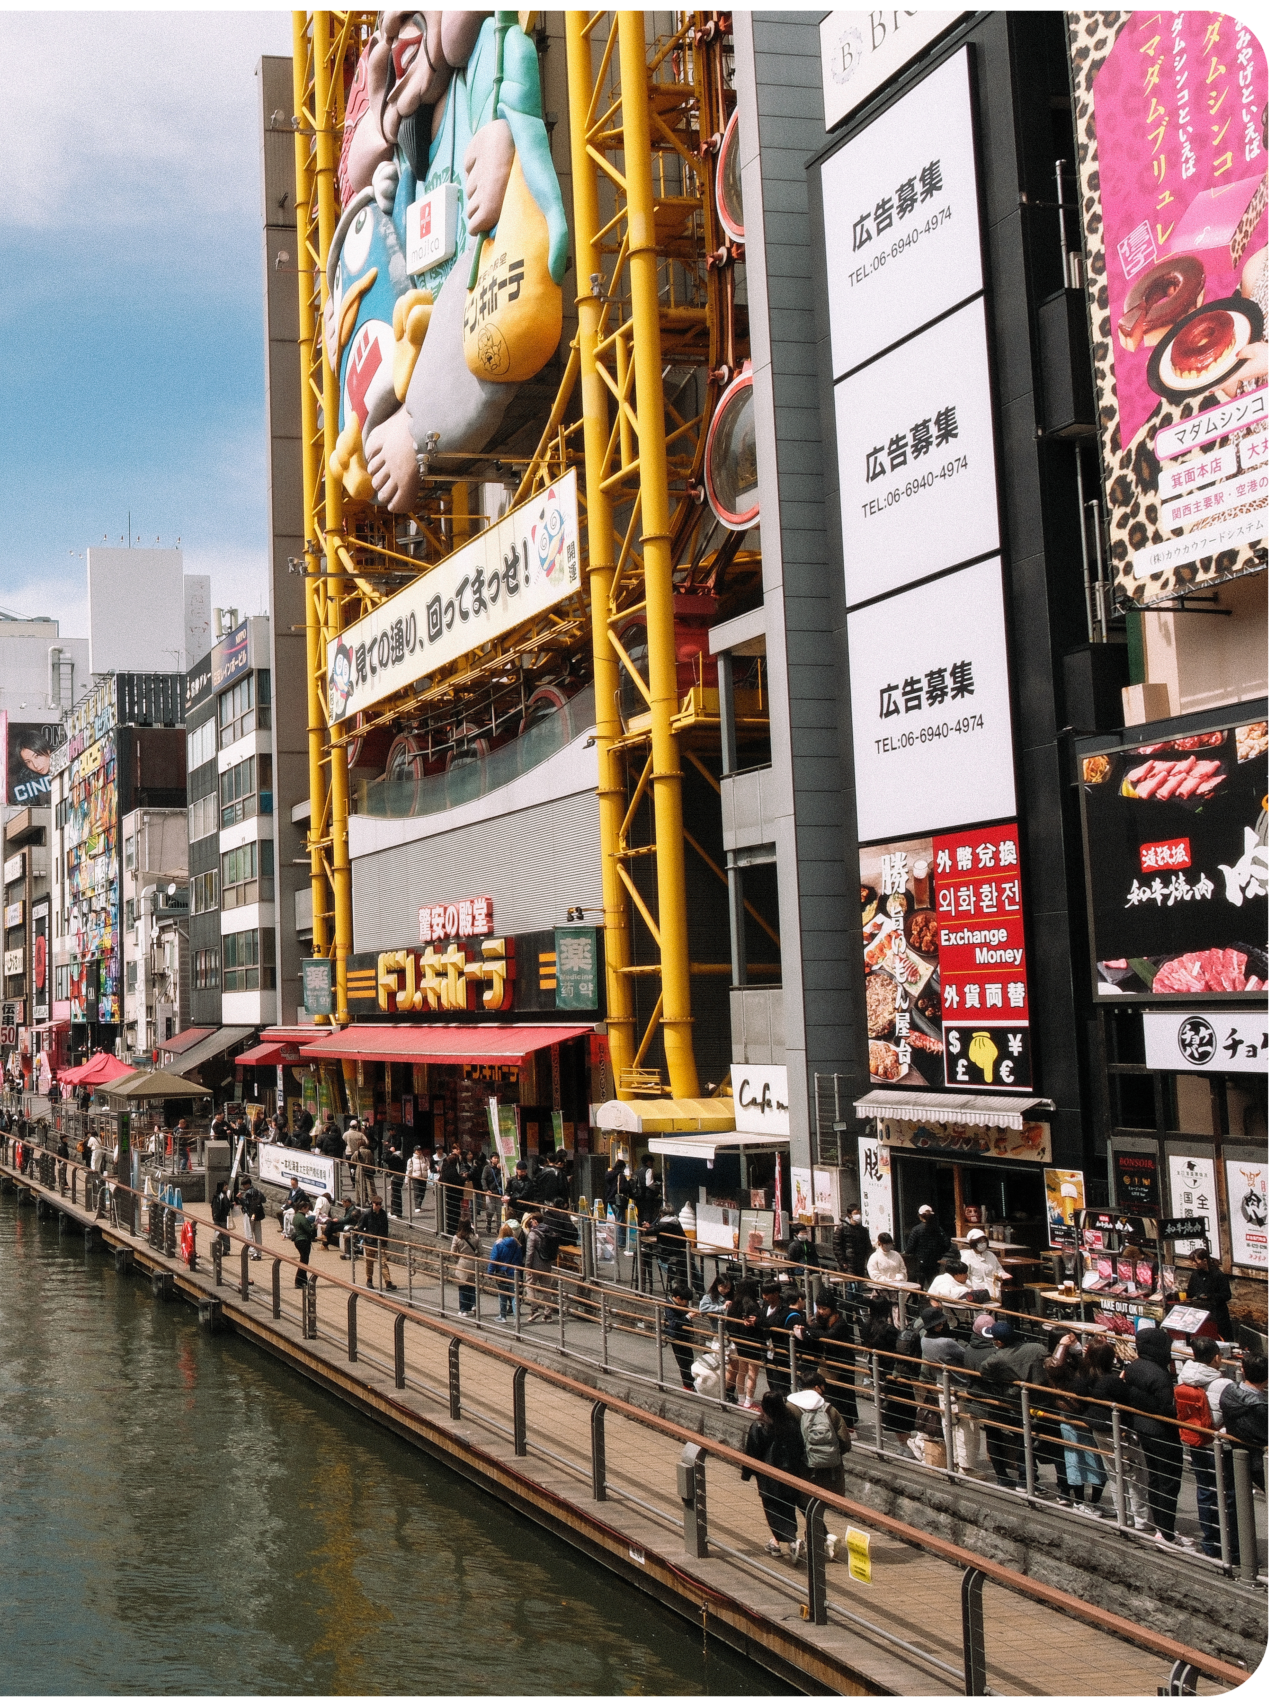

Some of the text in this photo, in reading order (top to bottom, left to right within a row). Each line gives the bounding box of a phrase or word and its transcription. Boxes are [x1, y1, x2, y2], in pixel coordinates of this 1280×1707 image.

[1172, 10, 1196, 180] ダムシンコといえば
[851, 159, 944, 253] 広告募集
[848, 205, 953, 288] TEL:06-6940-4974
[1174, 396, 1265, 445] マダムシンコ
[865, 405, 960, 485] 広告募集
[861, 455, 969, 519] TEL:06-6940-4974
[1171, 457, 1223, 490] 箕面本店
[878, 659, 976, 721] 広告募集
[874, 713, 985, 755] TEL:06-6940-4974
[881, 851, 910, 896] 勝
[1125, 871, 1215, 908] 和牛焼肉
[938, 879, 1021, 917] 외화환전
[418, 896, 490, 943] 驚安の殿堂
[940, 927, 1008, 946] Exchange
[559, 937, 593, 971] 薬
[975, 947, 1024, 966] Money
[305, 966, 329, 989] 薬
[579, 982, 594, 998] 약
[943, 981, 1027, 1010] 外貨両替
[0, 1026, 16, 1044] 50
[1119, 1157, 1155, 1169] BONSOIR
[1100, 1299, 1115, 1313] TAKE
[1115, 1301, 1129, 1314] OUT
[1128, 1304, 1138, 1315] OK
